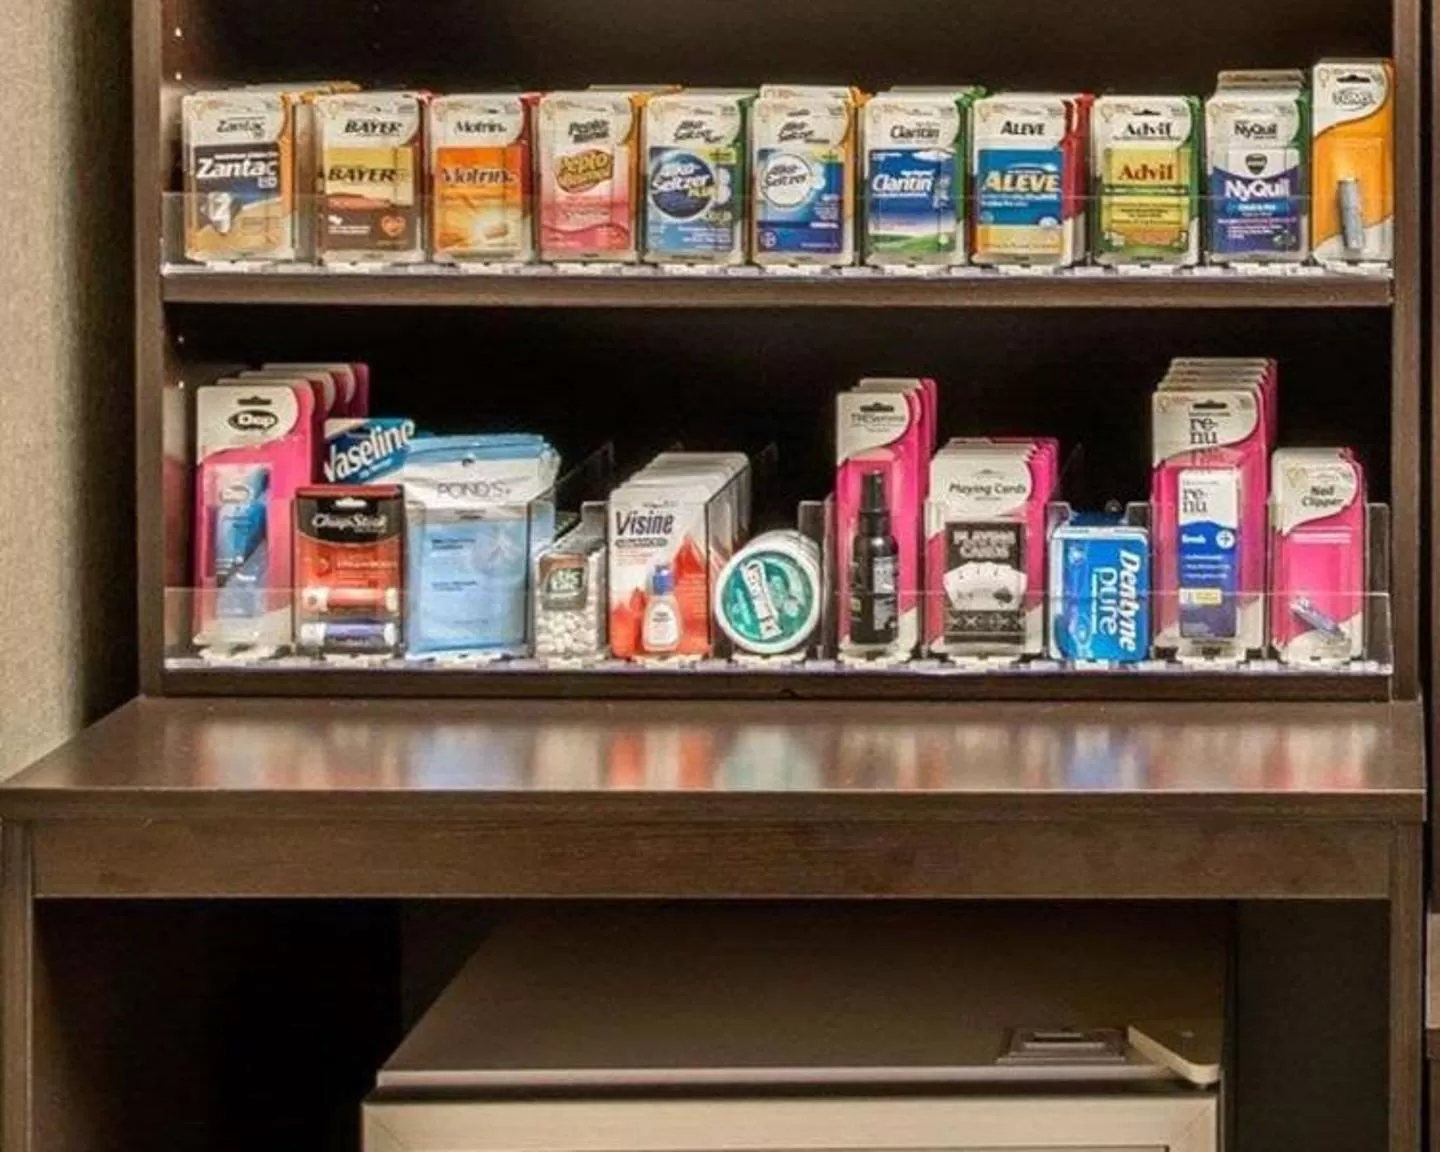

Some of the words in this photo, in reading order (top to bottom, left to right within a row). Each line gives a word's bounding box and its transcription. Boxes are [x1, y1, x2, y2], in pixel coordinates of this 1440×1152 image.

[343, 118, 403, 135] BAYER
[890, 124, 940, 140] Claritin
[1000, 120, 1046, 136] ALEVE
[1124, 122, 1172, 139] Advil
[1233, 123, 1277, 139] NyQuil
[196, 155, 278, 180] Zantac
[327, 166, 397, 184] BAYER
[1118, 163, 1174, 181] Advil
[871, 172, 933, 192] Claritin
[983, 172, 1060, 193] ALEVE
[1224, 178, 1291, 201] NyQuil
[323, 418, 416, 483] Vaseline
[948, 482, 992, 496] Playing
[615, 510, 675, 537] Visine
[1093, 566, 1119, 636] pure
[1118, 550, 1143, 654] Dentyne
